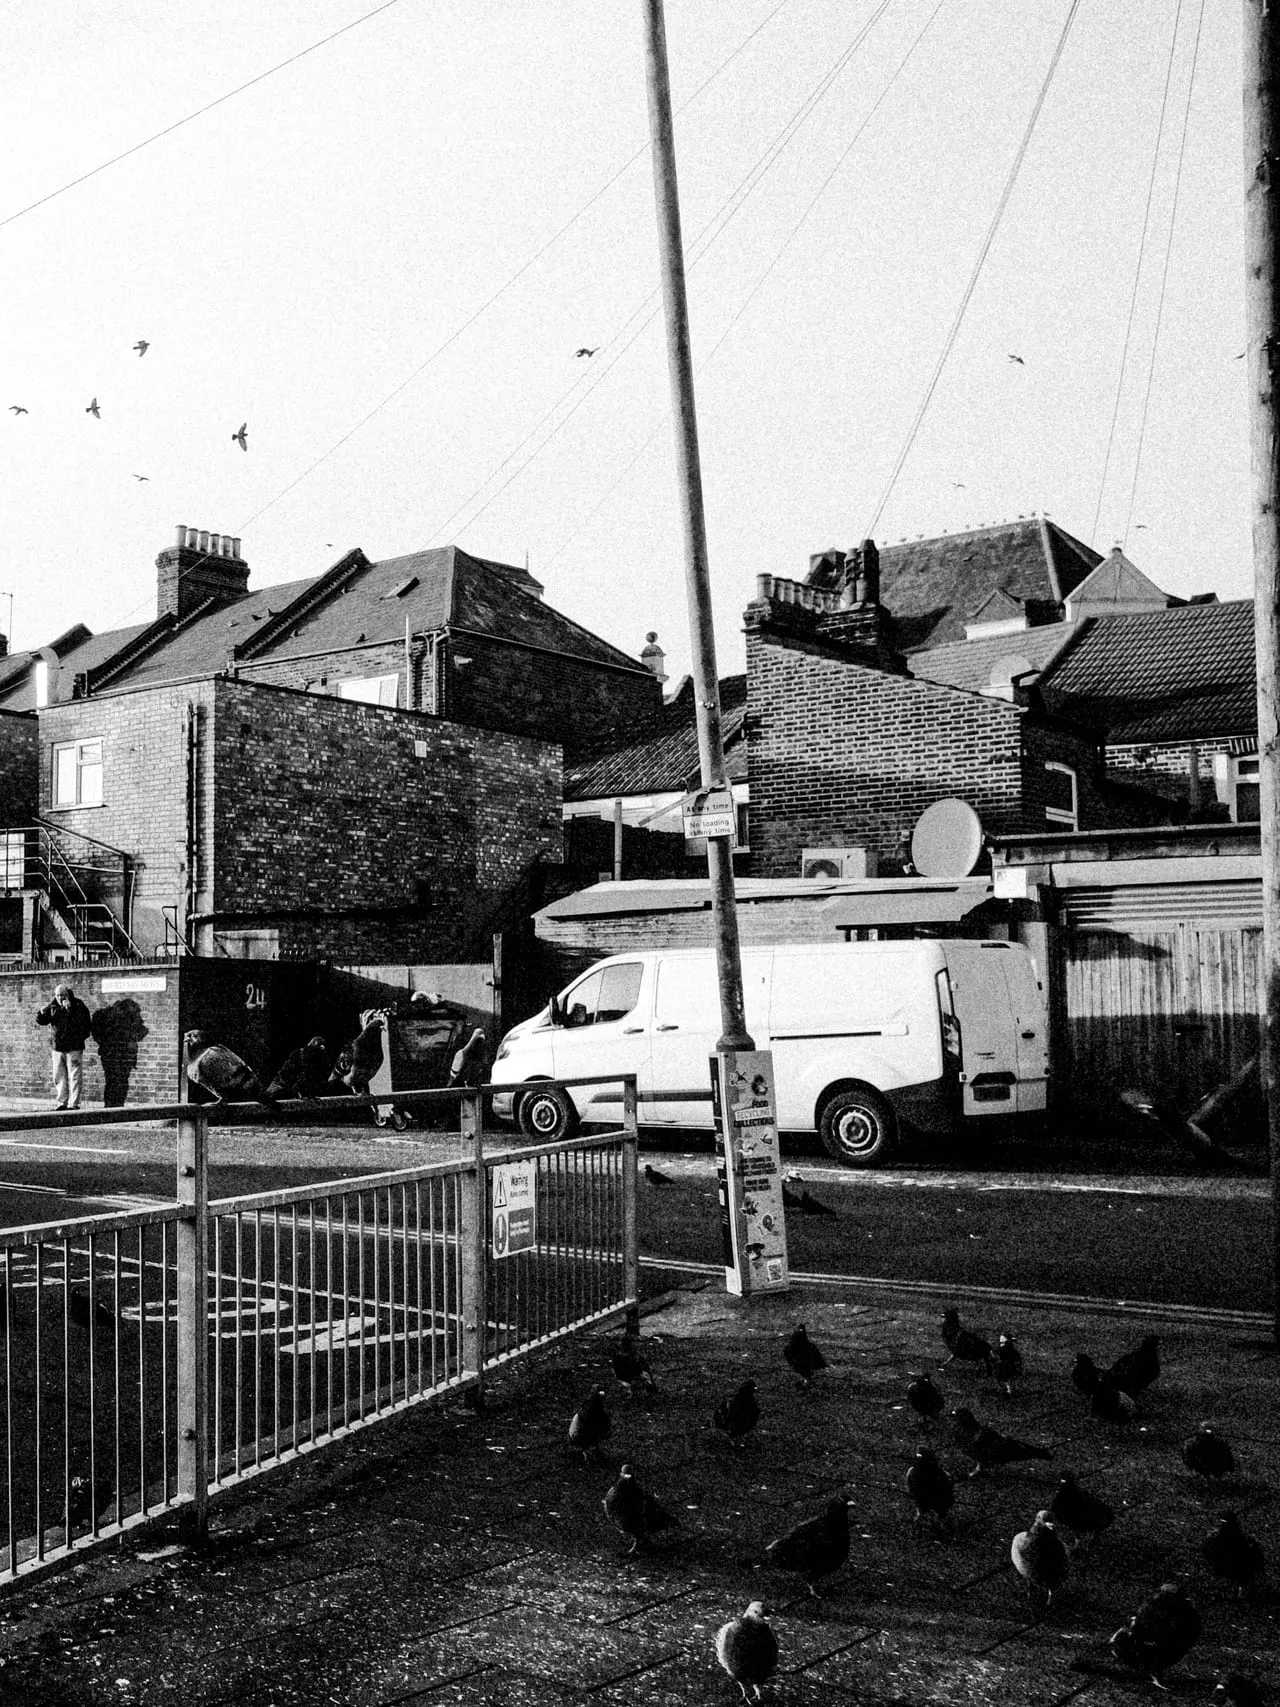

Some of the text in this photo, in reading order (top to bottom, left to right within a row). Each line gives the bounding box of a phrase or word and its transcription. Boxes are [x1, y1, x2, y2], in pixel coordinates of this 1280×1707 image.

[713, 802, 729, 810] time
[689, 819, 729, 829] No loading
[245, 983, 267, 1009] 24
